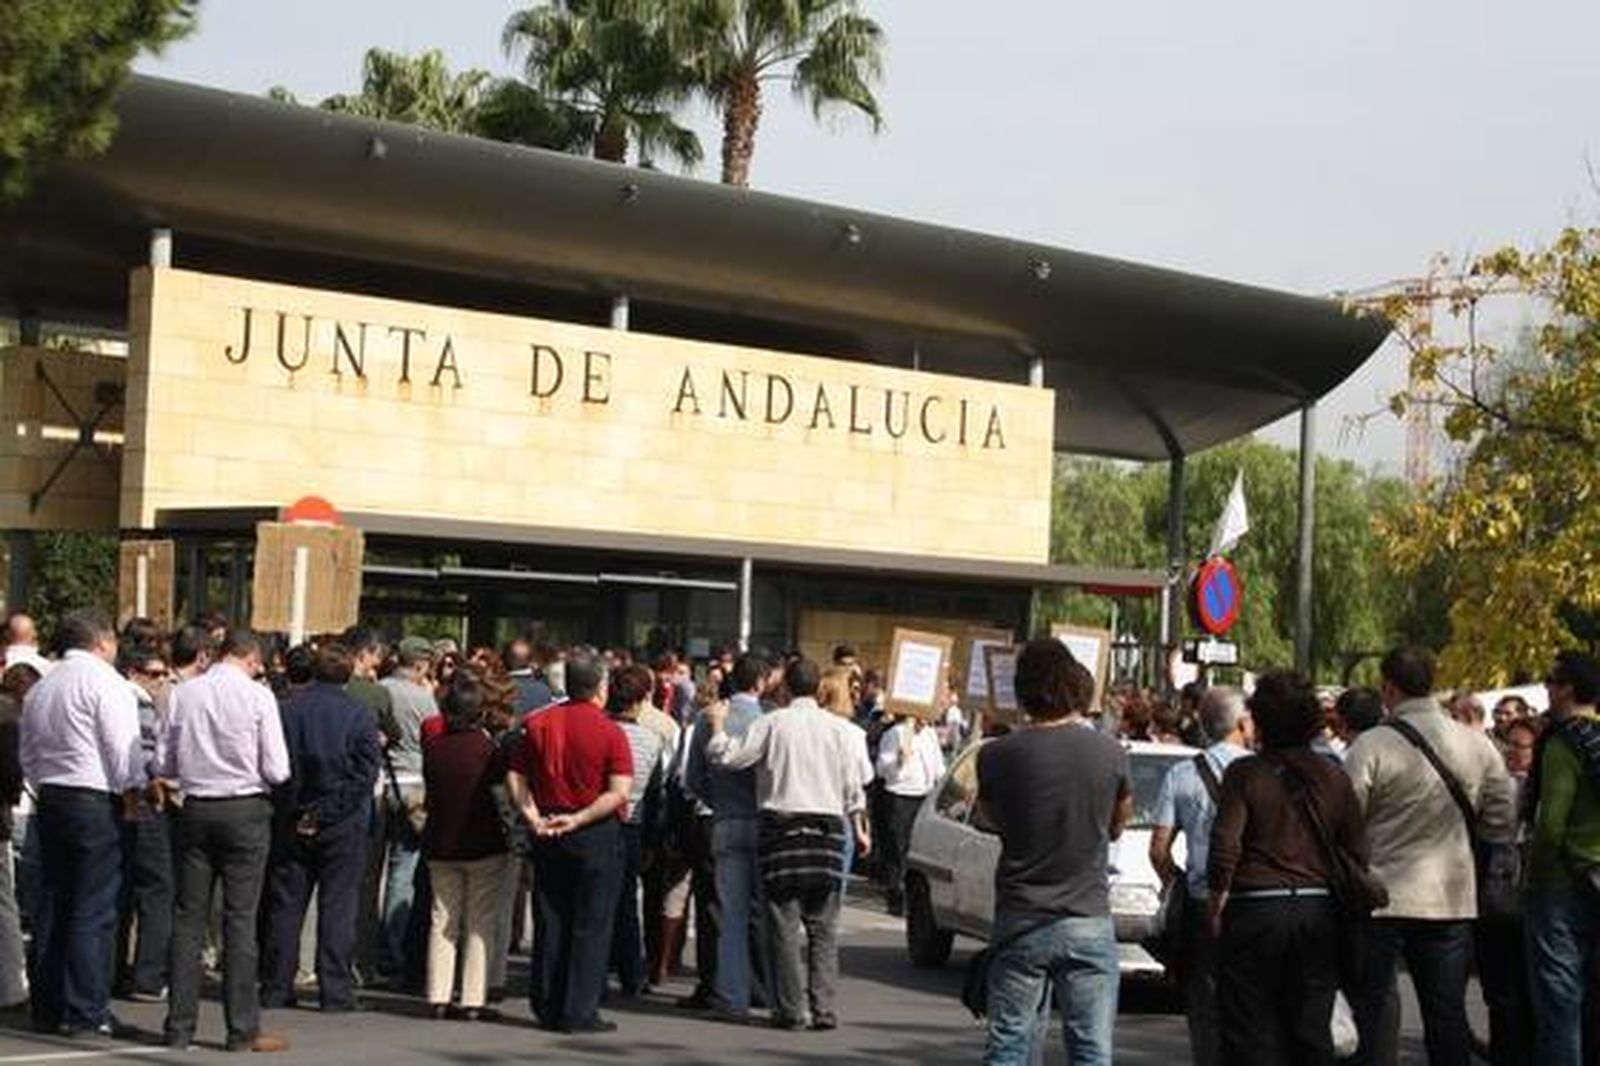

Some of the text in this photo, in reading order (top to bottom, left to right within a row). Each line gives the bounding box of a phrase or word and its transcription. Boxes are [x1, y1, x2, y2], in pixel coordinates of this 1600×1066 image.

[224, 308, 1006, 449] JUNTA DE ANDALUCIA
